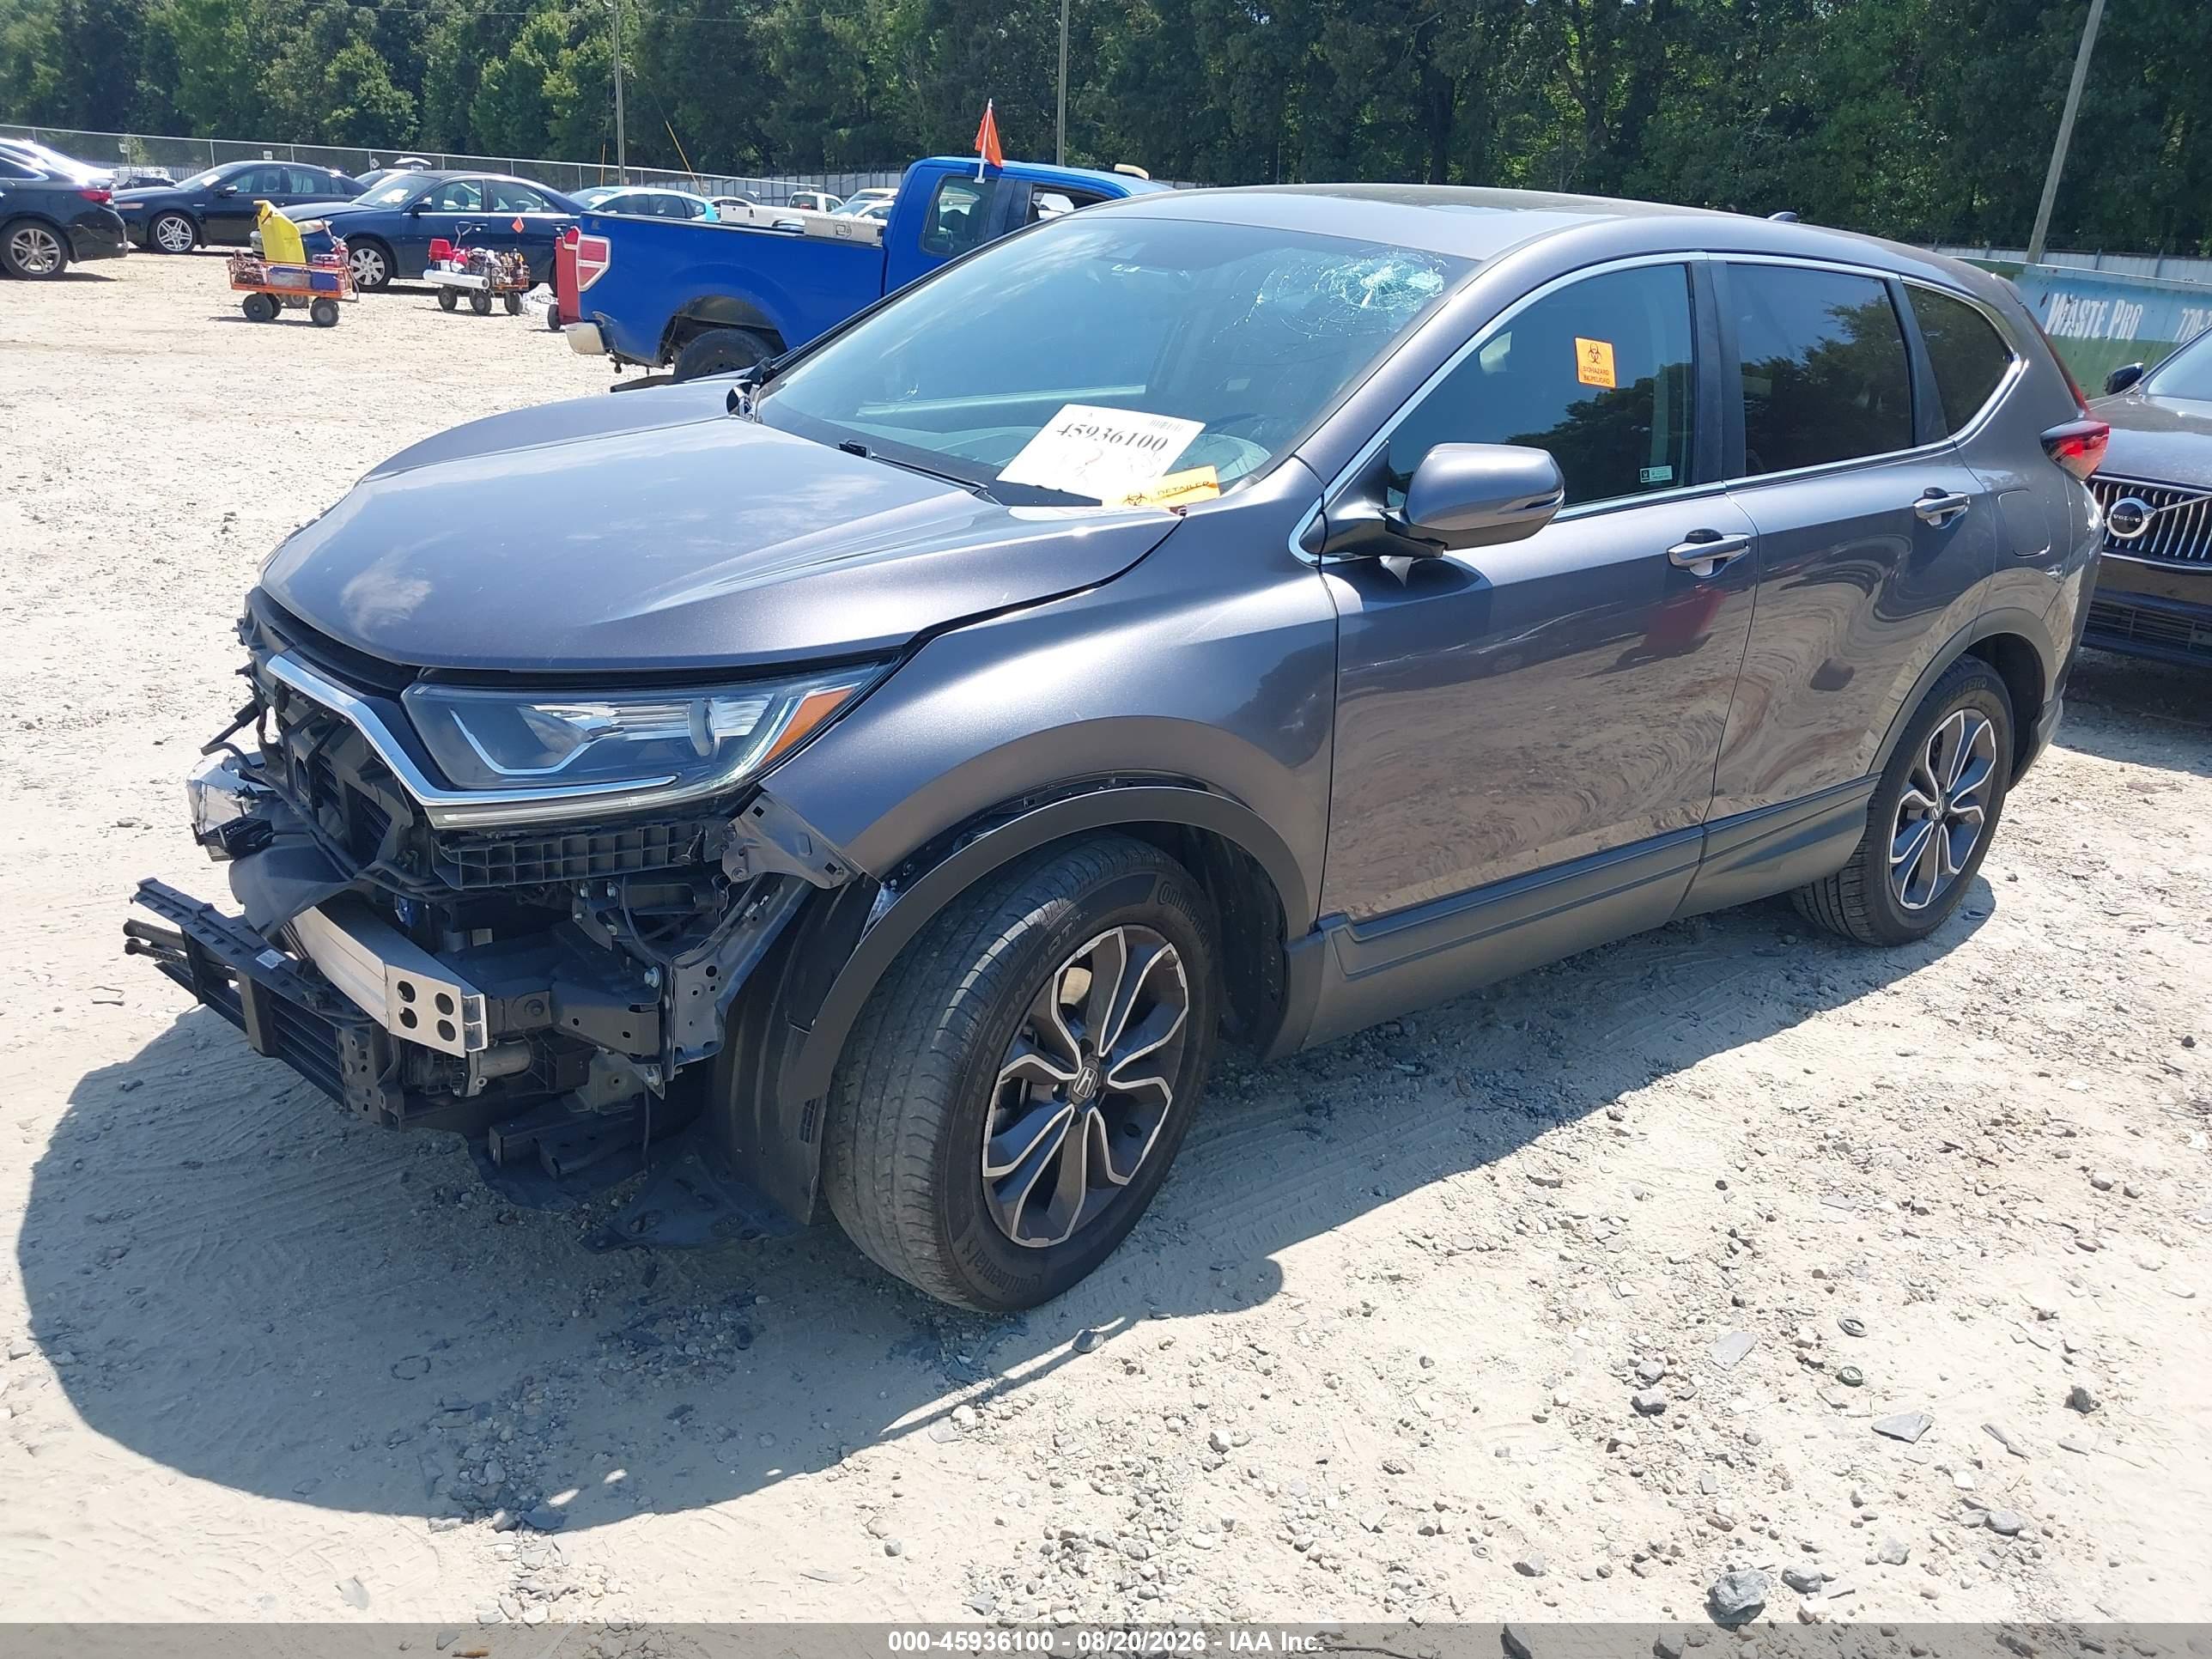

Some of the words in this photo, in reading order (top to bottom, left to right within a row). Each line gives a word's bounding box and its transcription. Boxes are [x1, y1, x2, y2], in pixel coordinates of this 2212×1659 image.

[2045, 293, 2108, 339] WASTE
[2107, 299, 2144, 341] PRO
[1056, 422, 1169, 453] 45936100
[2112, 514, 2142, 522] VOLVO
